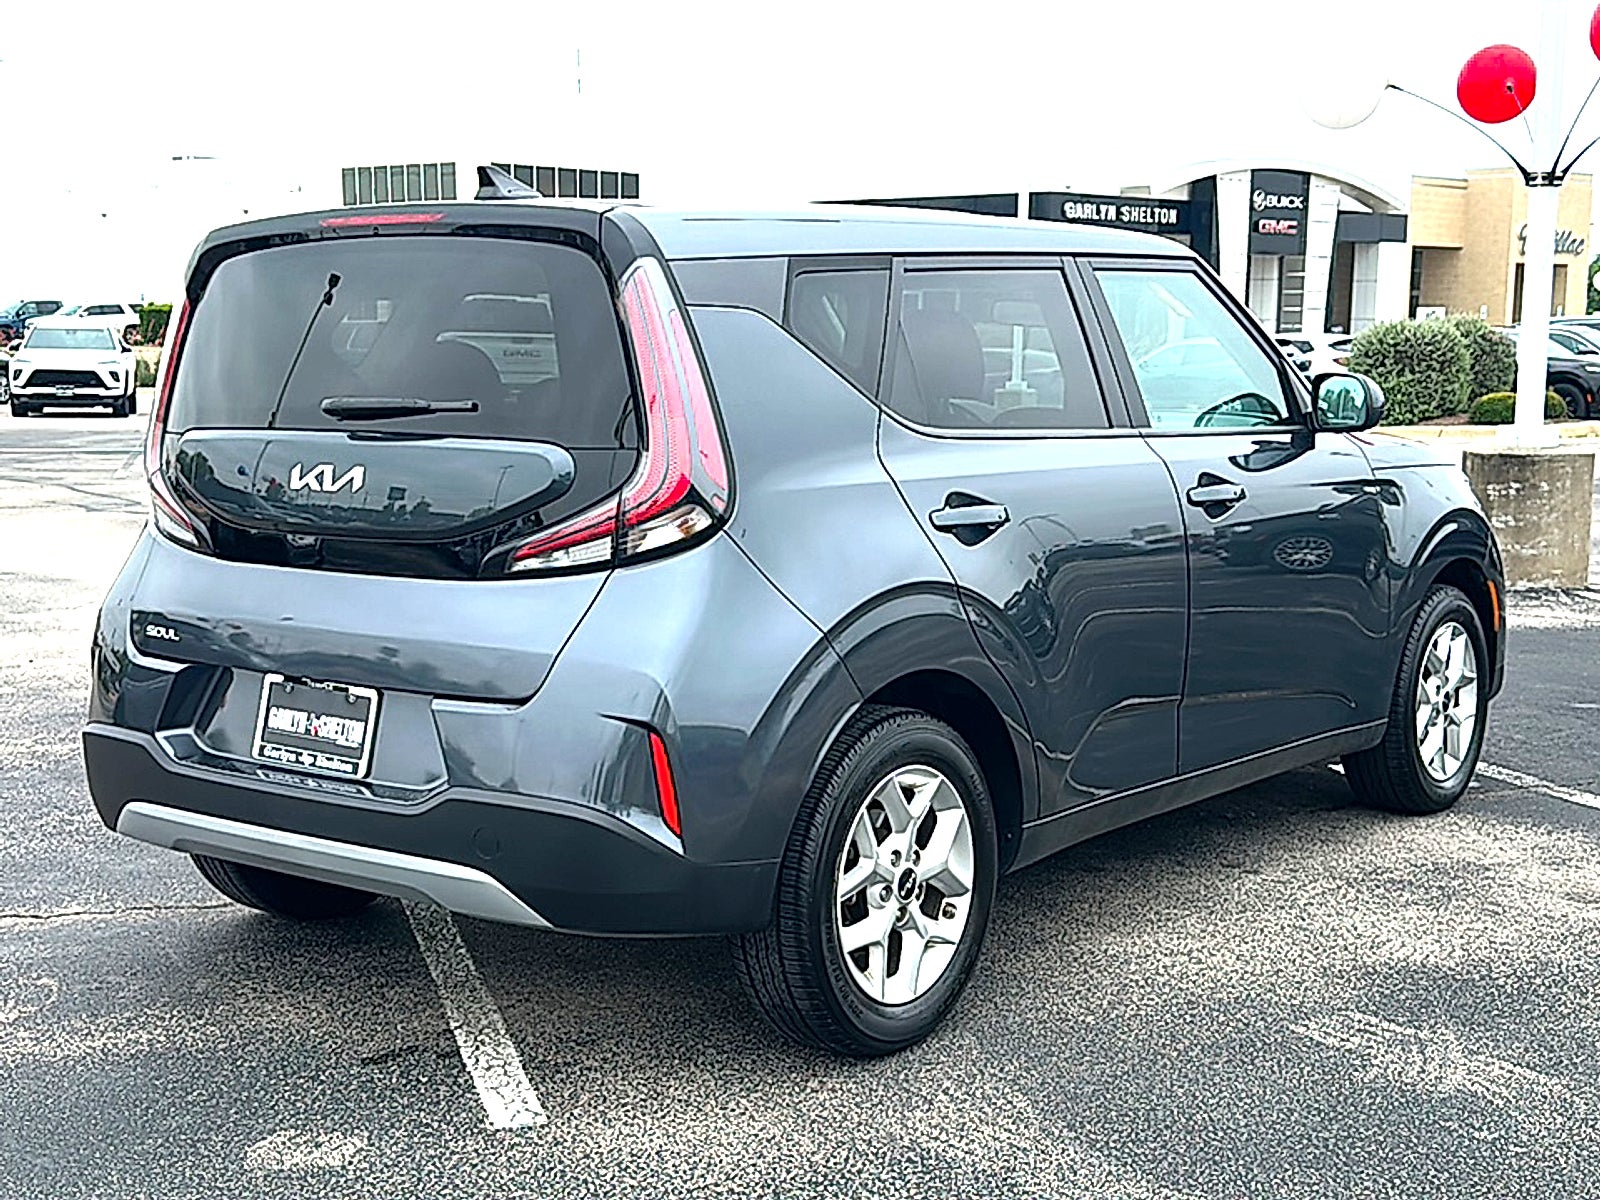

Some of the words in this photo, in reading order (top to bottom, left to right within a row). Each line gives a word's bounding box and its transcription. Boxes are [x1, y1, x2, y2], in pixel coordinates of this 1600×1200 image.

[1266, 194, 1304, 209] BUICK
[1063, 201, 1117, 221] GARLYN
[1119, 205, 1178, 225] SHELTON
[1258, 218, 1299, 235] GMC
[289, 462, 365, 493] KIA
[145, 624, 180, 641] SOUL
